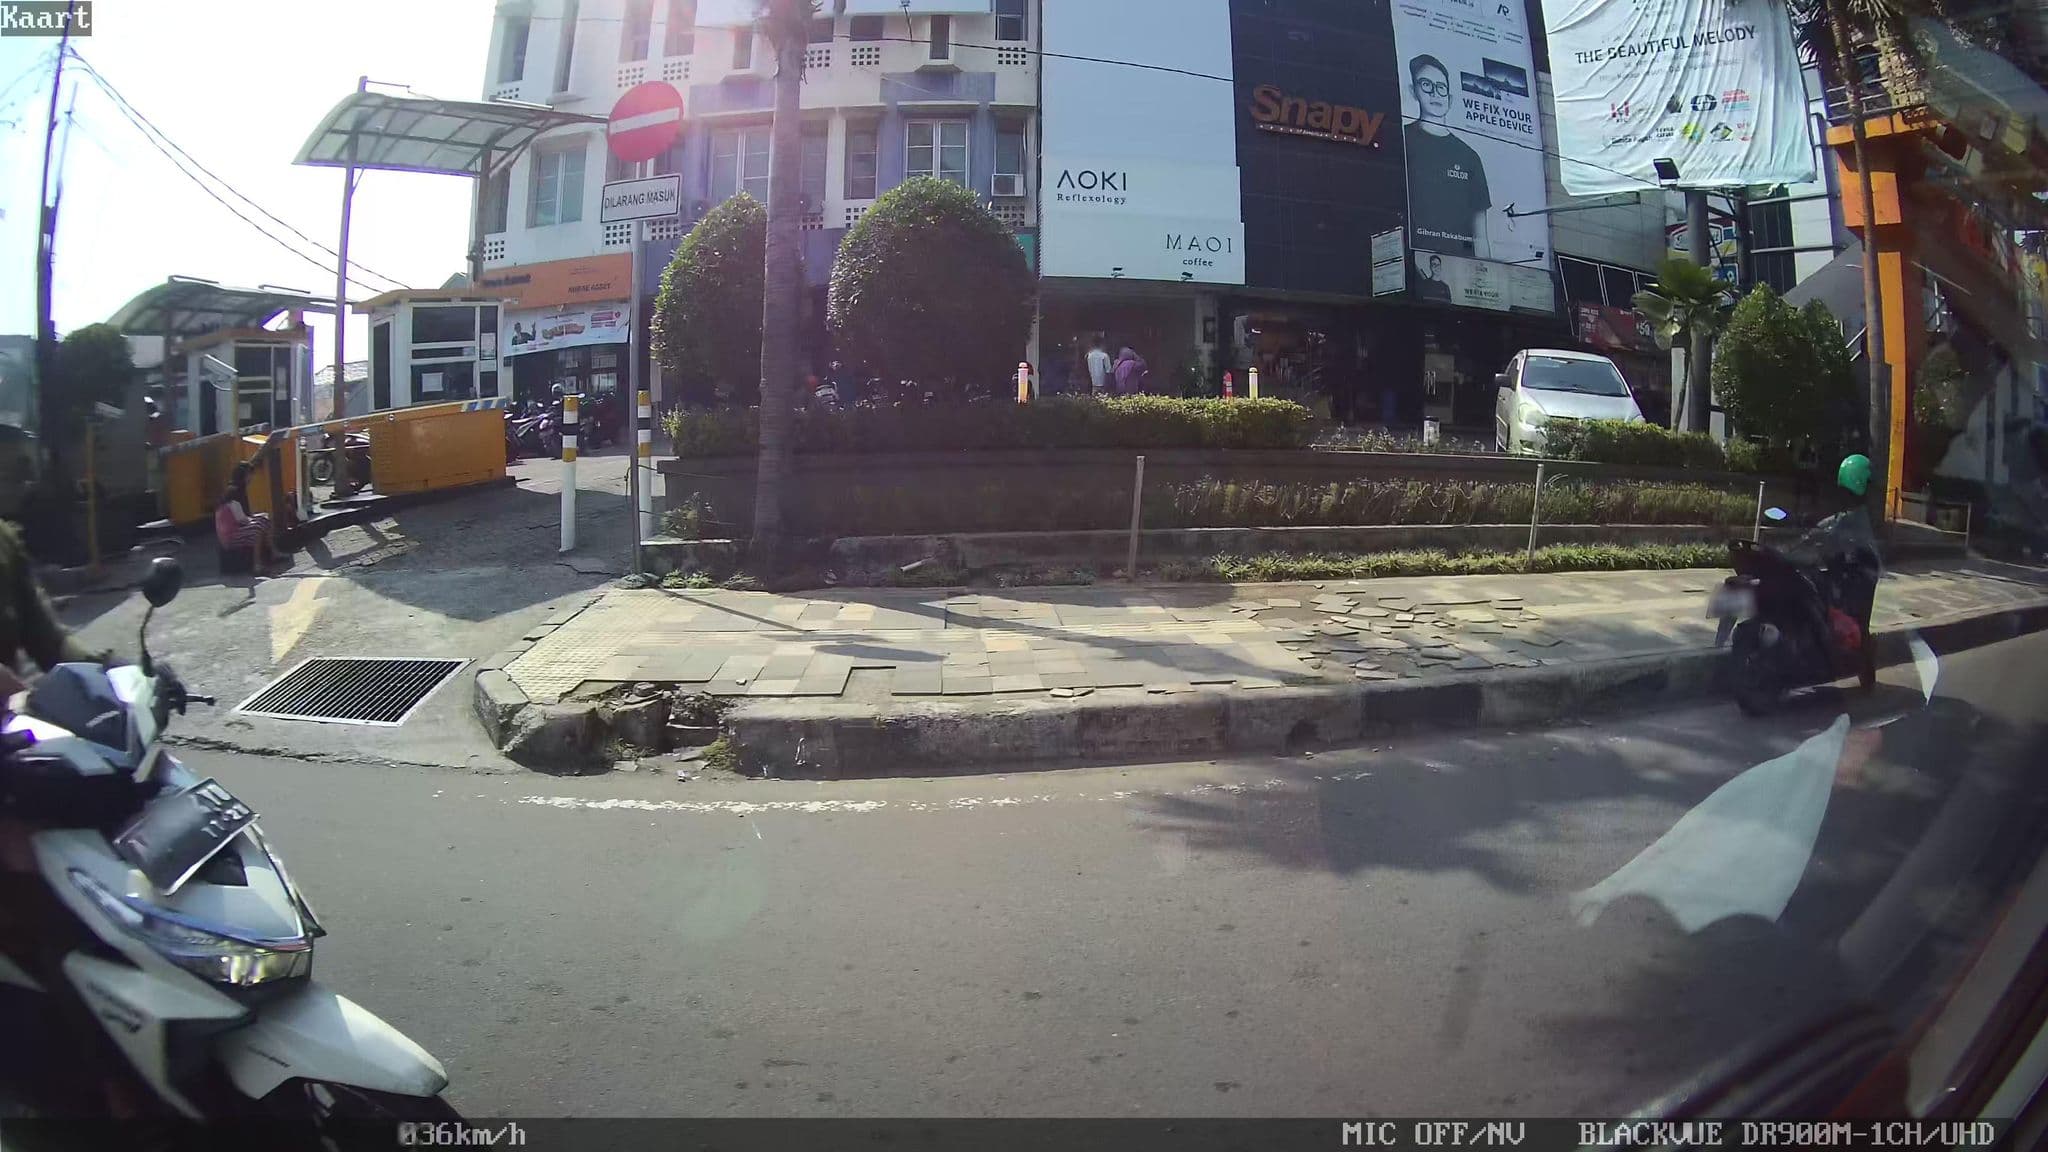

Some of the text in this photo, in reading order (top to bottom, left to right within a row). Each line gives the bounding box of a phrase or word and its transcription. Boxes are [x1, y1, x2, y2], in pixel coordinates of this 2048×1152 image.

[1575, 48, 1604, 65] THE
[1608, 36, 1690, 60] BEAUTIFUL
[1693, 25, 1756, 47] MELODY
[1251, 84, 1385, 146] Snapy
[1463, 98, 1532, 124] WE FIX YOUR
[1466, 111, 1498, 126] APPLE
[1500, 118, 1534, 135] DEVICE
[1057, 170, 1127, 191] AOKI
[605, 187, 675, 209] DILARANG MASUK
[1057, 193, 1127, 206] Reflexology
[1417, 227, 1441, 237] Gibran
[1166, 234, 1232, 254] MAOI
[1182, 257, 1214, 267] coffee
